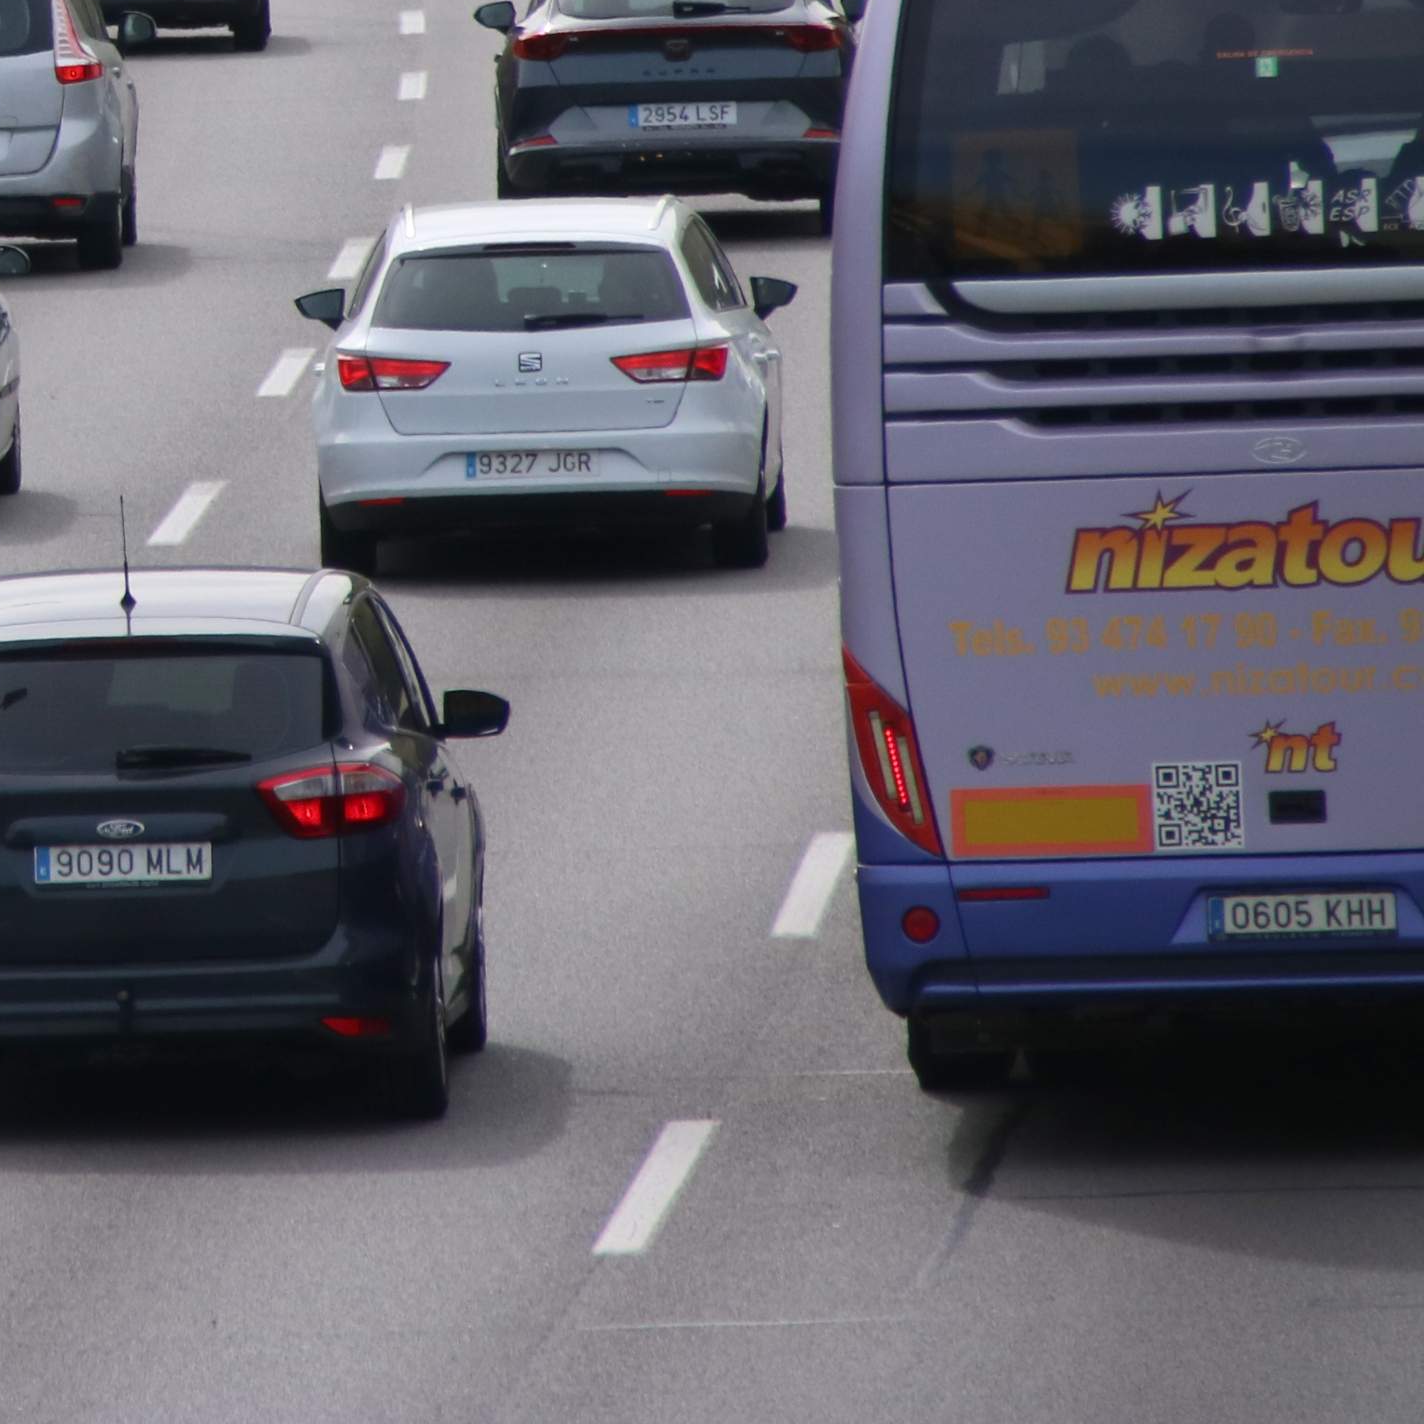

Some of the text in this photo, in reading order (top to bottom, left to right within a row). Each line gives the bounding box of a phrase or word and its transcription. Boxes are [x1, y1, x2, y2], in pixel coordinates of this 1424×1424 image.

[643, 104, 731, 123] 2954 LSF
[1329, 206, 1371, 221] ESP
[479, 452, 591, 474] 9327 JGR
[950, 618, 1035, 657] Tels.
[1047, 617, 1090, 653] 93
[1101, 614, 1168, 649] 474
[1181, 613, 1222, 649] 17
[1235, 612, 1278, 648] 90
[1311, 610, 1391, 647] Fax.
[1265, 722, 1342, 774] nt
[56, 849, 134, 876] 9090
[146, 847, 203, 874] MLM
[1232, 898, 1387, 929] 0605 KHH
